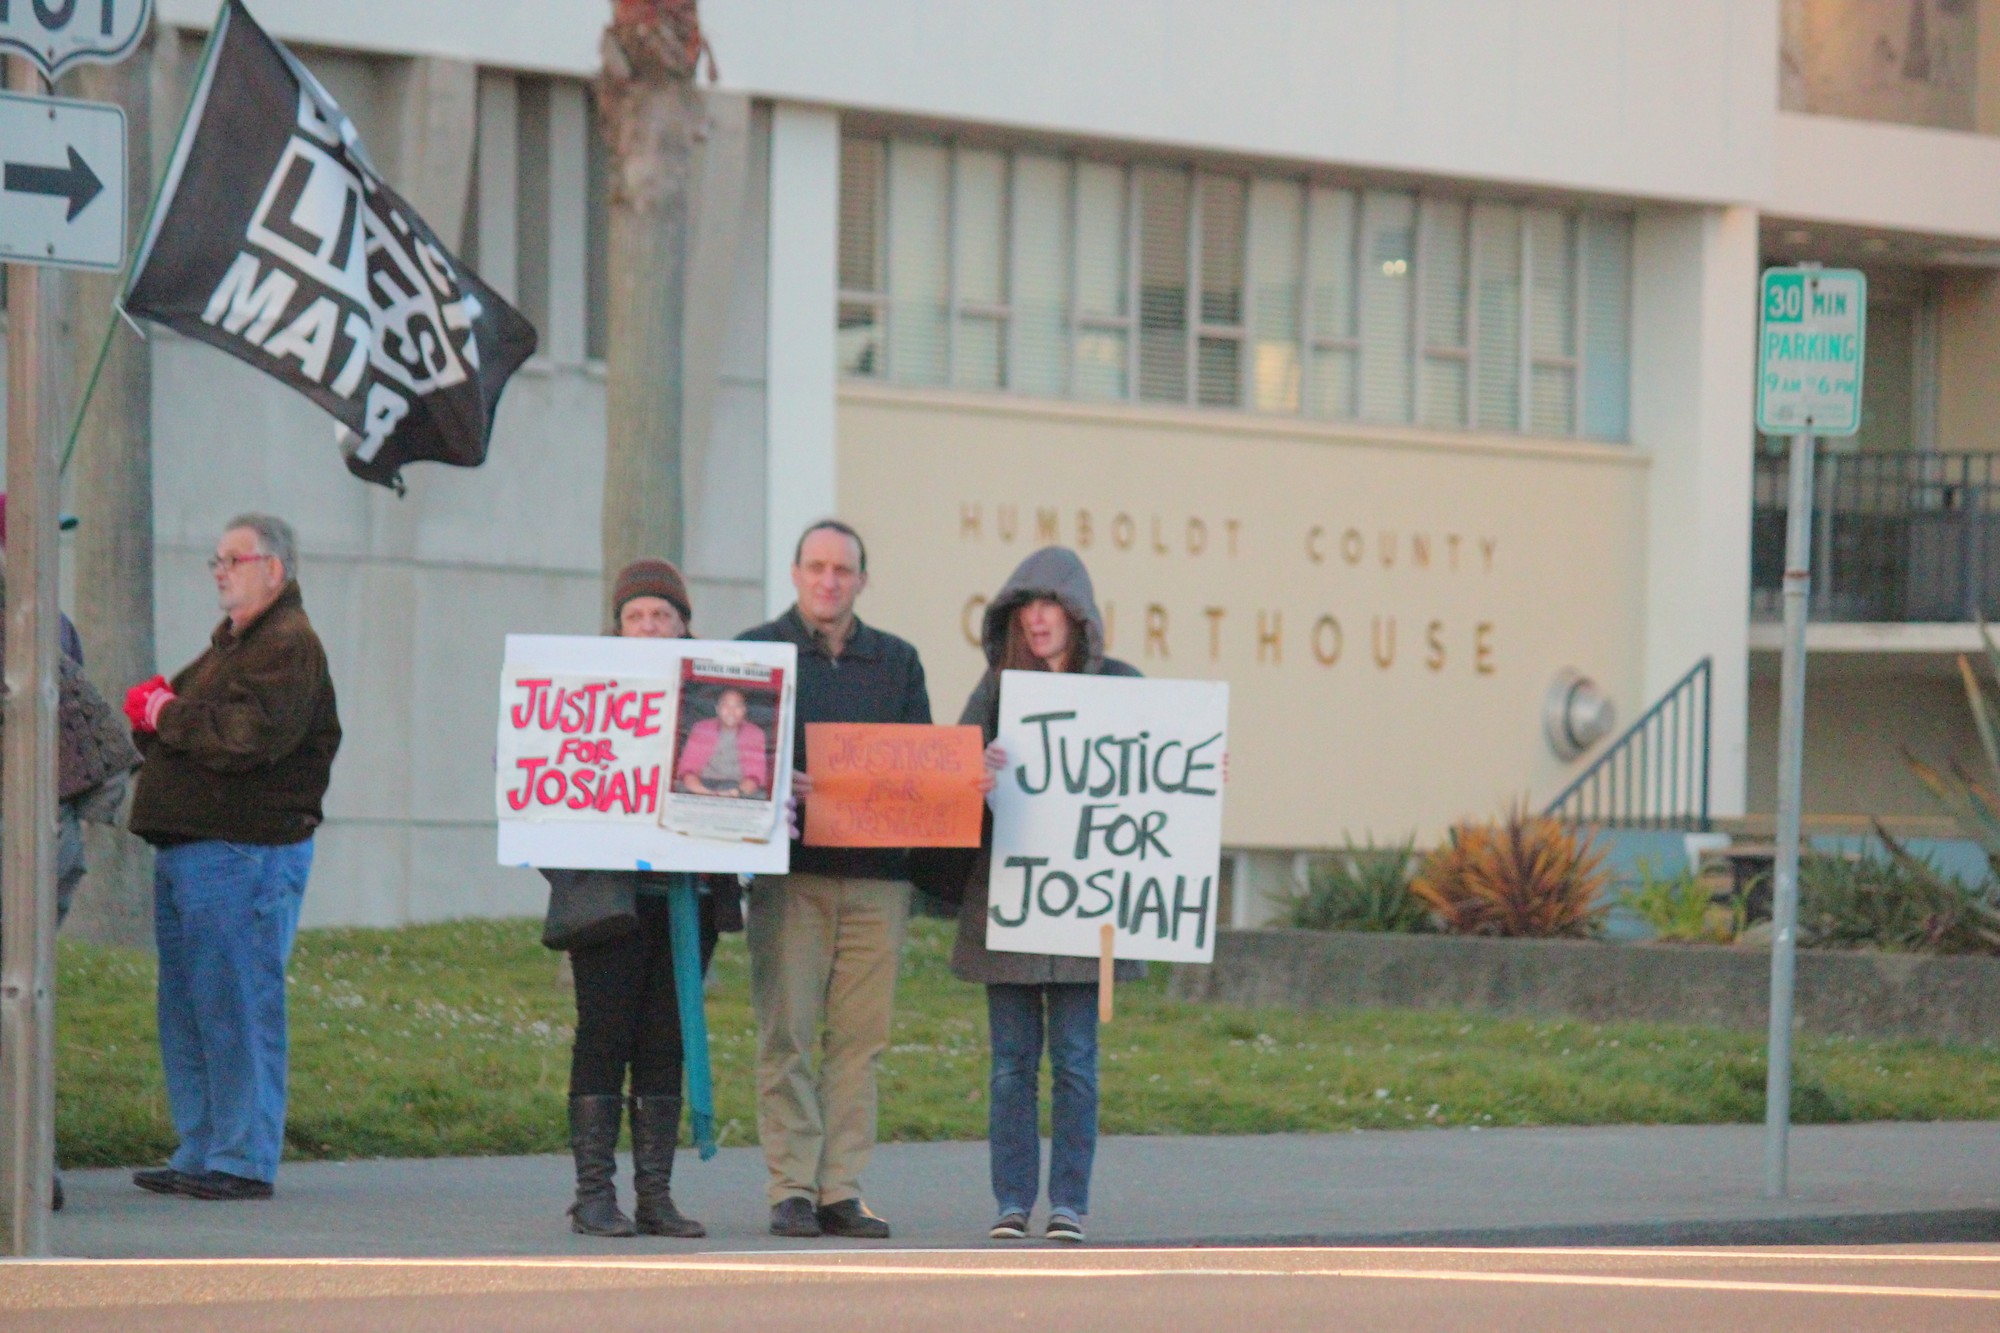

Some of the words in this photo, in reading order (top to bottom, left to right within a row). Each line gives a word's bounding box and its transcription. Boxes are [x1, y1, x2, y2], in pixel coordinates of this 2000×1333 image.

[1768, 284, 1801, 319] 30
[1812, 292, 1847, 316] MIN
[1768, 332, 1856, 362] PARKING
[959, 503, 1242, 557] HUMBOLDT
[1305, 524, 1498, 572] COUNTY
[960, 594, 1496, 676] CRTHOUSE
[556, 738, 618, 764] FOR
[1074, 803, 1172, 860] FOR
[989, 855, 1211, 949] JOSIAH
